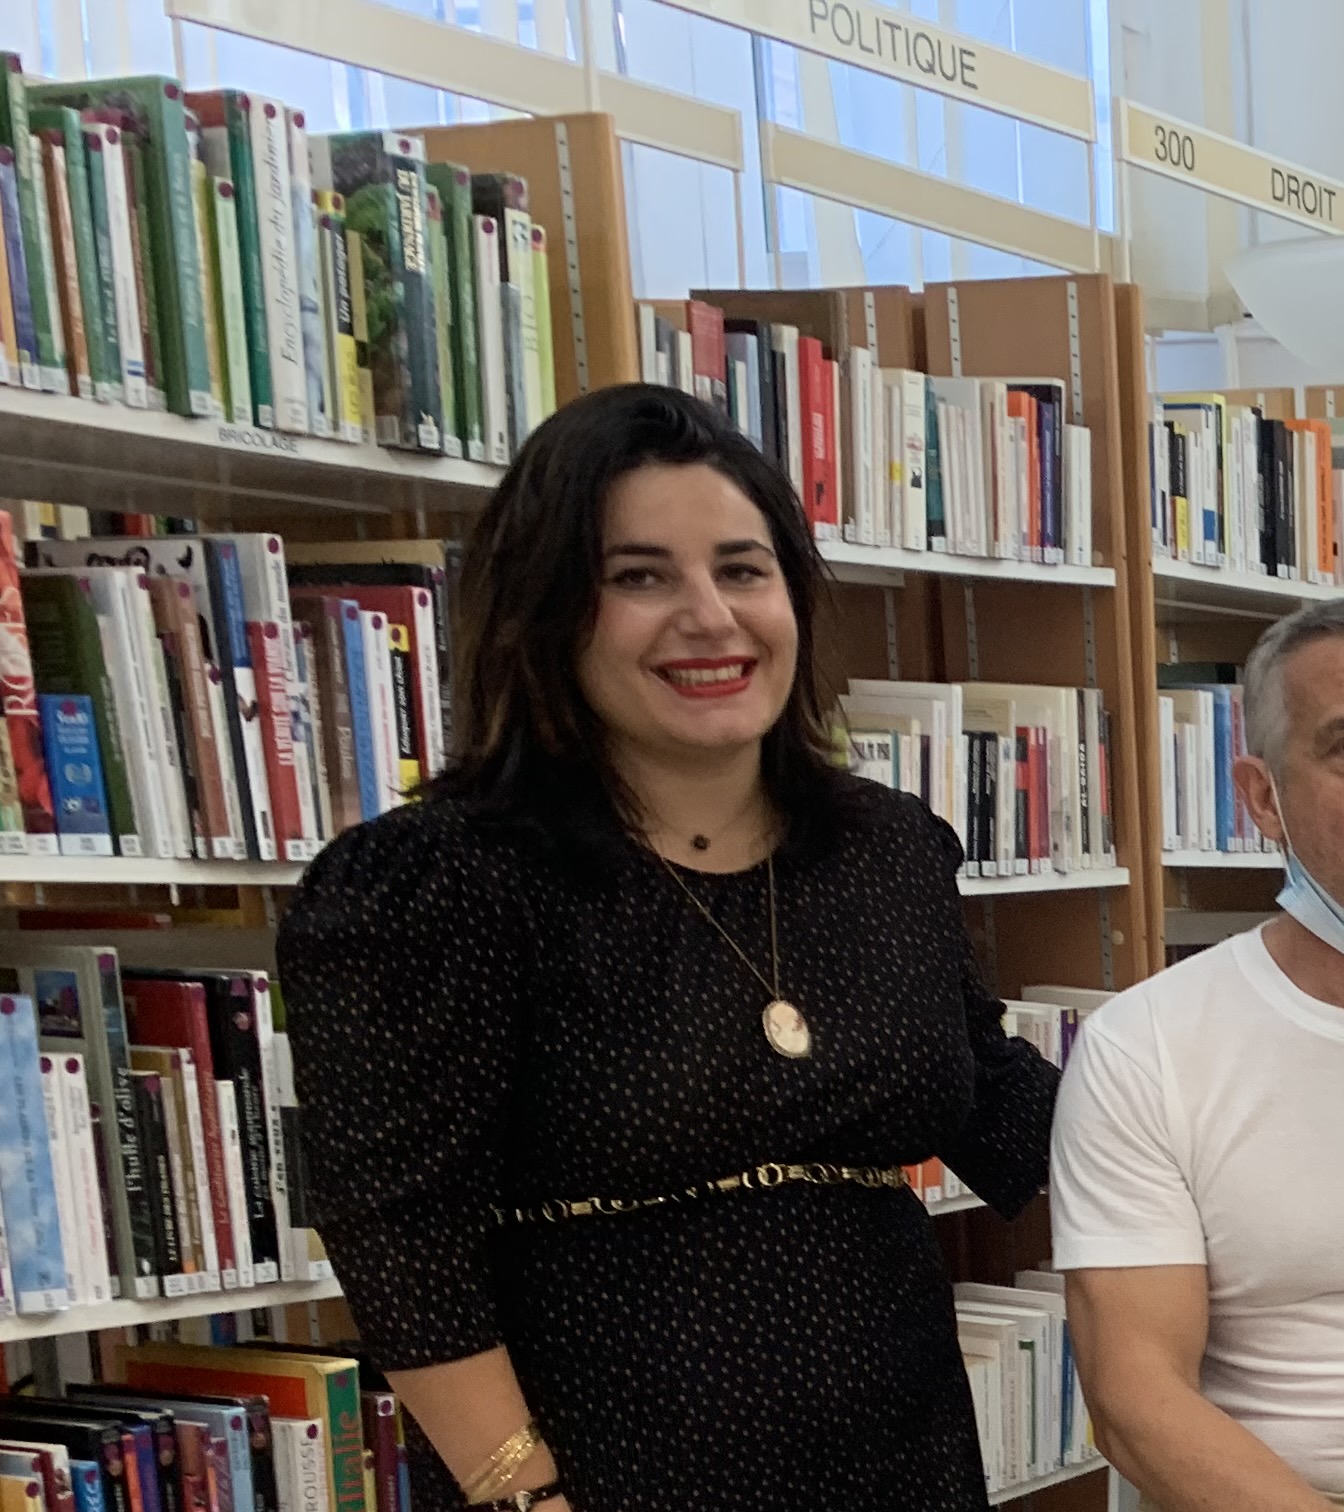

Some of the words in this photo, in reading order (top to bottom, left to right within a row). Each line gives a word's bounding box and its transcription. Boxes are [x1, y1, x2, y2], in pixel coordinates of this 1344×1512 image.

[809, 0, 979, 91] POLITIQUE
[1154, 124, 1195, 171] 300
[1270, 166, 1337, 222] DROIT
[217, 426, 299, 454] BRICOLAGE
